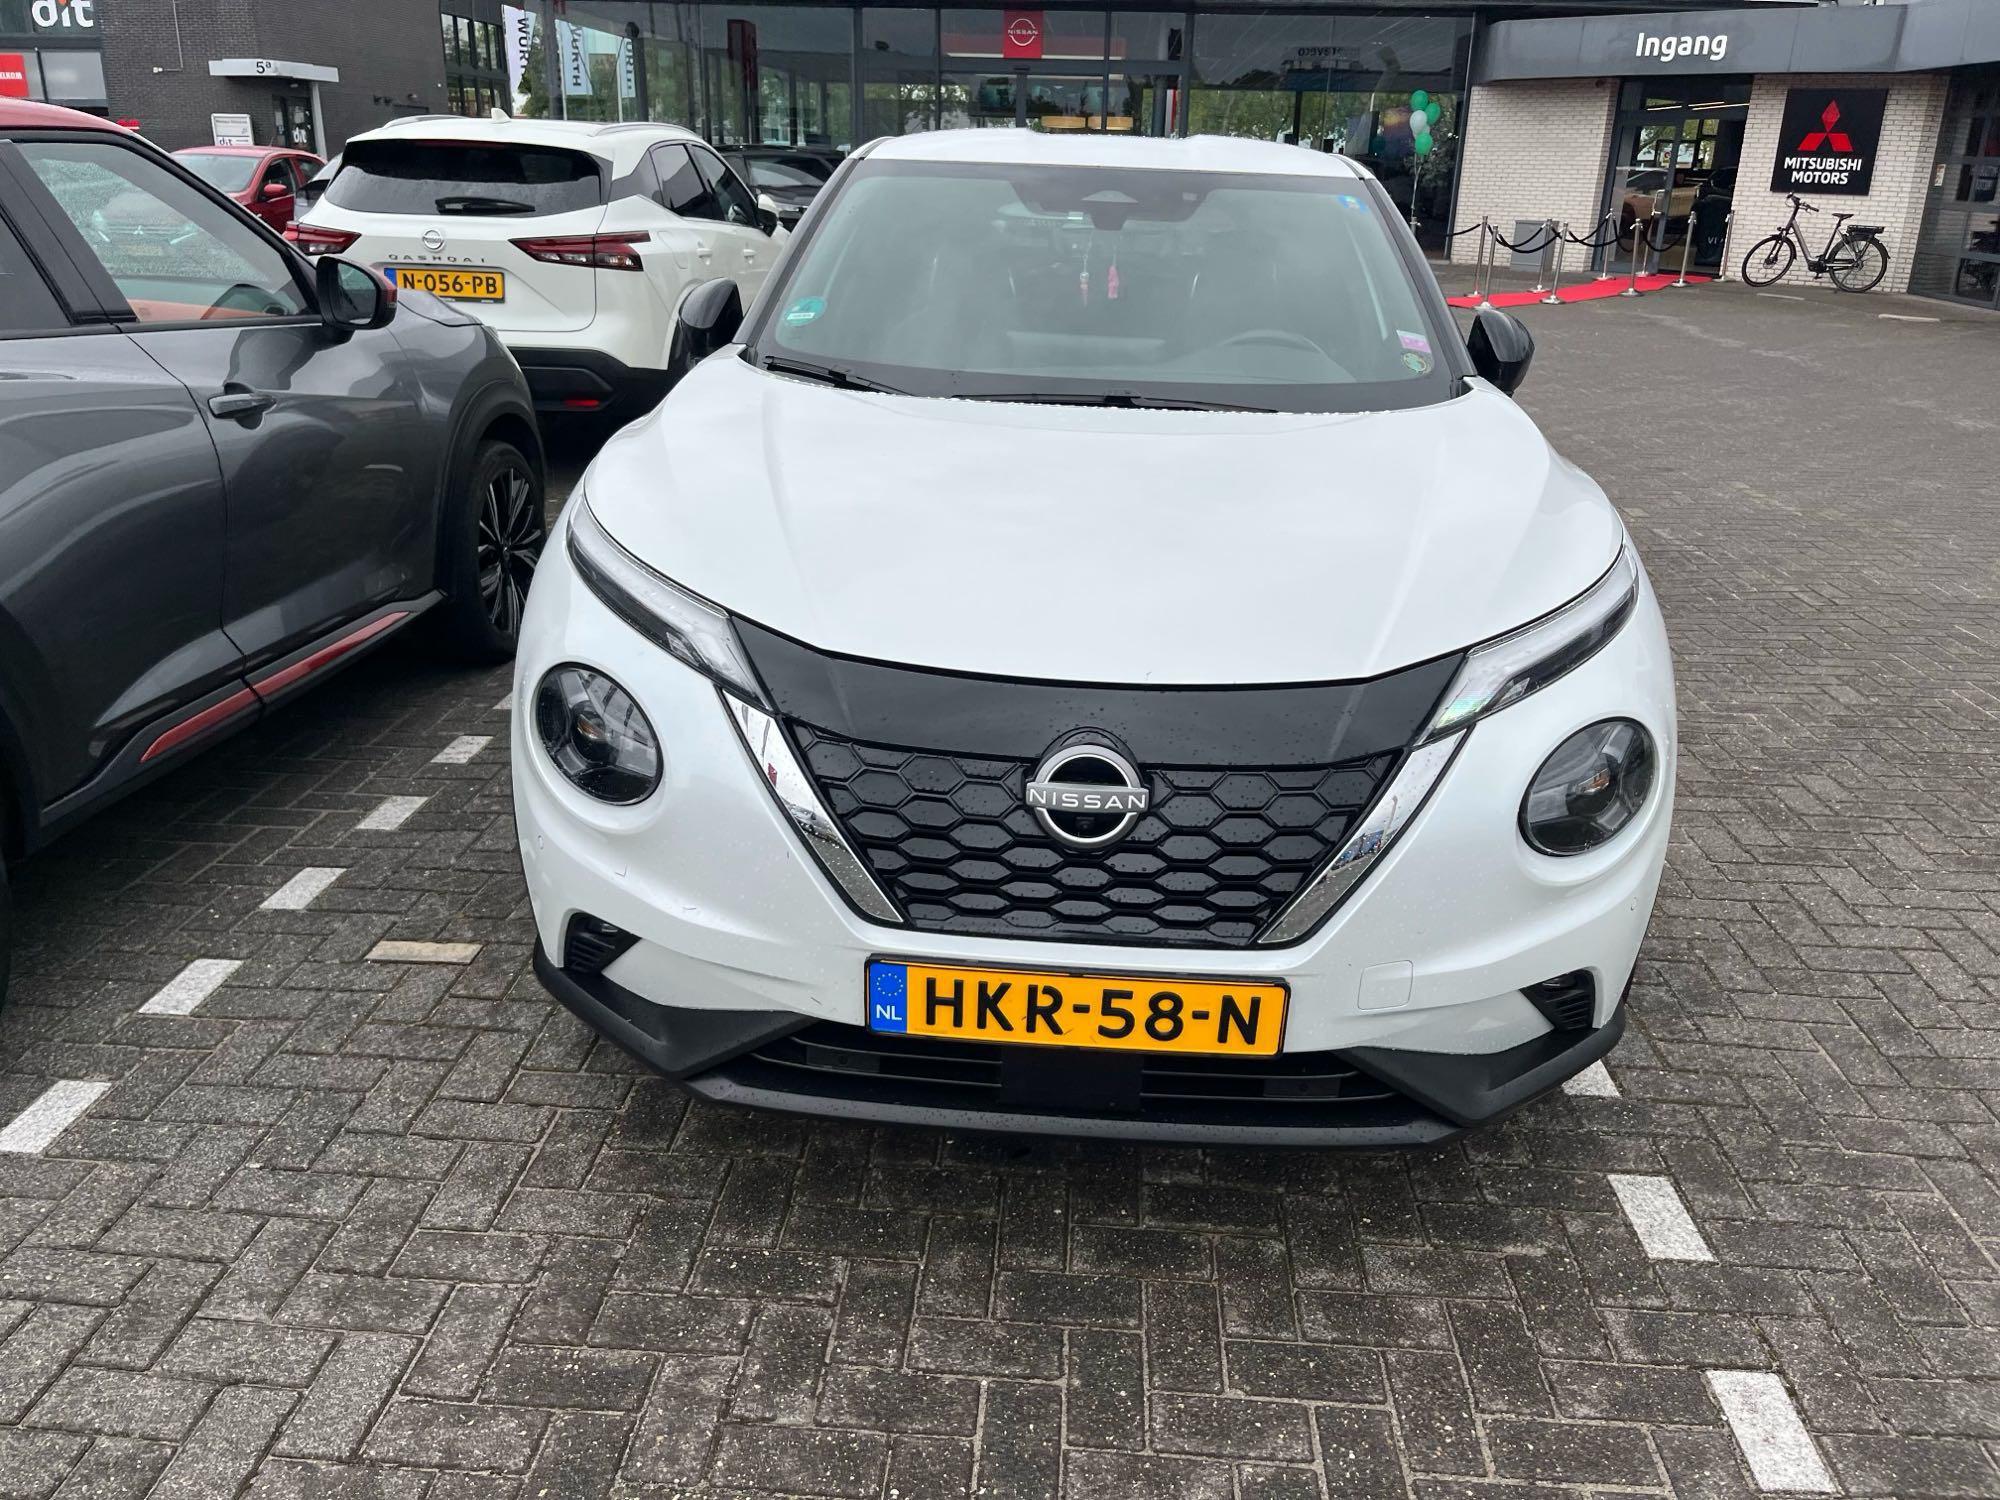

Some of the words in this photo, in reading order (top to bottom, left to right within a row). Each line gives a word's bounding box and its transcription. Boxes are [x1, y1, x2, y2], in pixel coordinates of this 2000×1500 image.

[32, 0, 94, 28] dit
[1635, 32, 1728, 62] Ingang
[1783, 157, 1862, 171] MITSUBISHI
[1791, 170, 1849, 185] MOTORS
[388, 254, 485, 263] QASHQAI
[402, 272, 498, 294] N-056-PB
[1029, 788, 1146, 810] NISSAN
[875, 1003, 903, 1021] NL
[924, 976, 1262, 1046] HKR-58-N
